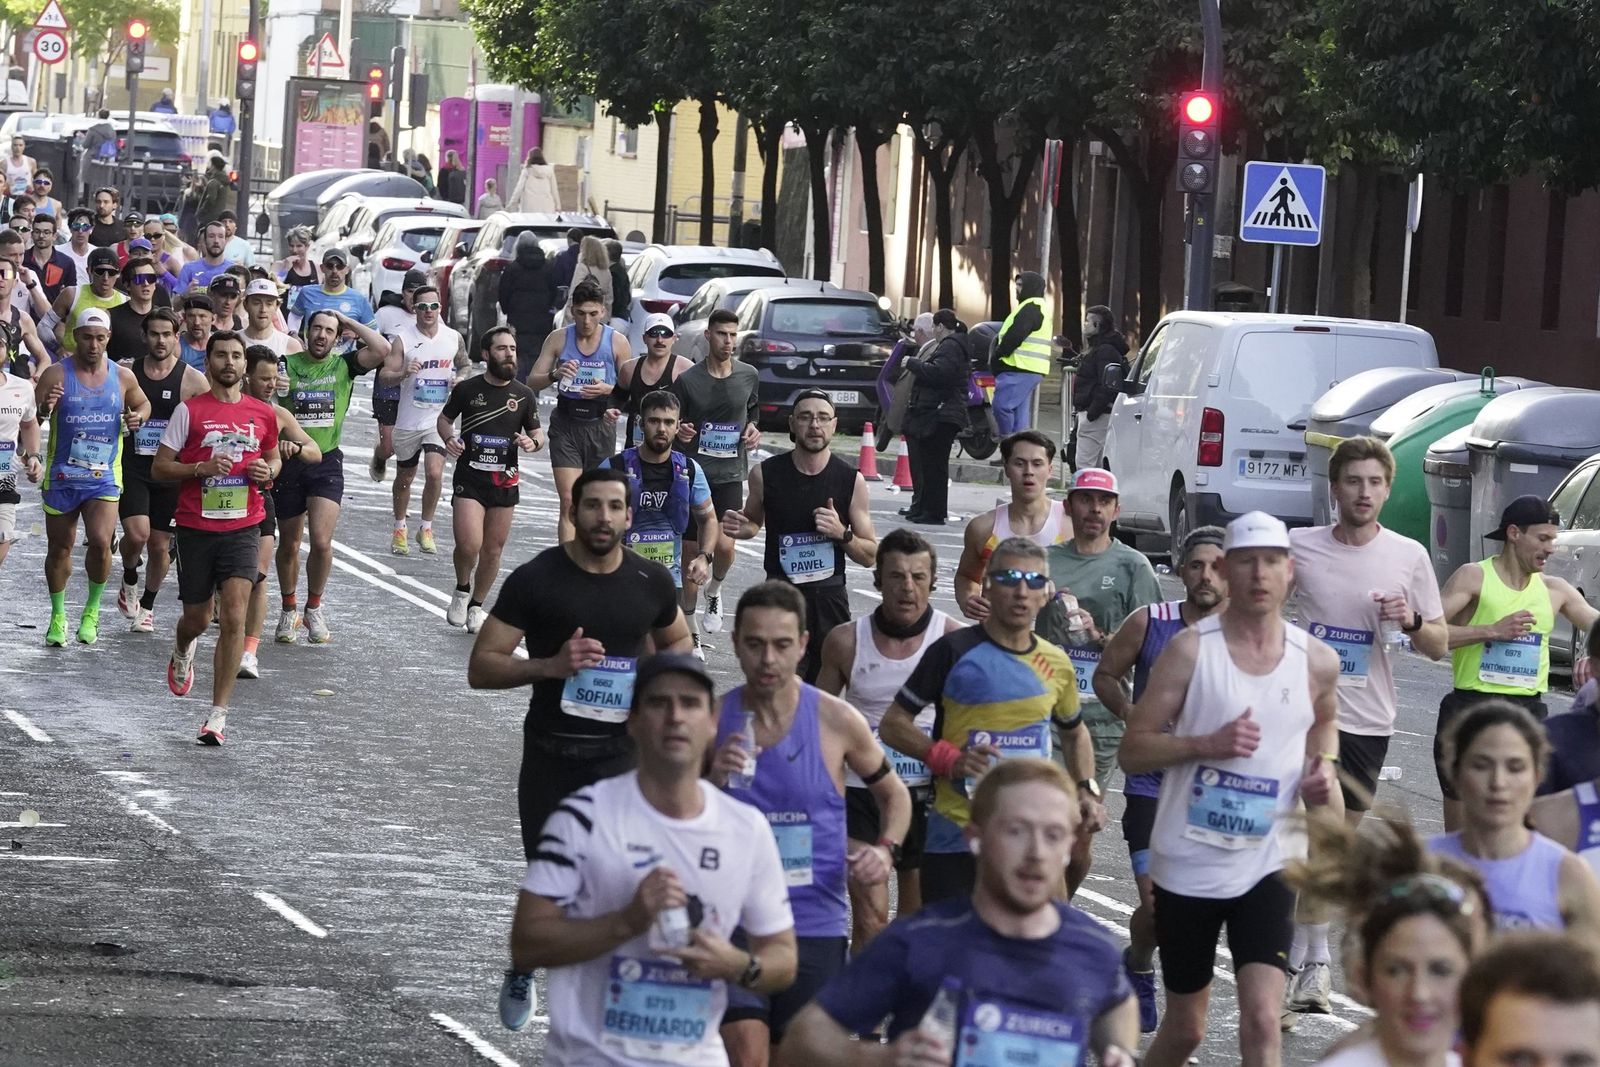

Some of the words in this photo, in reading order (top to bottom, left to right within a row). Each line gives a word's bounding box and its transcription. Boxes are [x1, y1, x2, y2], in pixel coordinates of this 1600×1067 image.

[41, 41, 61, 53] 30
[318, 411, 335, 419] PÉREZ
[699, 441, 738, 450] ALEJANDRO
[479, 454, 498, 464] SUSO
[1247, 462, 1279, 476] 9177
[1283, 464, 1308, 477] MFY
[218, 478, 244, 486] ZURICH
[218, 500, 234, 509] J.E.
[640, 491, 668, 508] CV
[796, 534, 828, 544] ZURICH
[790, 559, 825, 573] PAWEŁ
[1329, 629, 1367, 642] ZURICH
[1068, 648, 1102, 660] ZURICH
[597, 660, 631, 670] ZURICH
[576, 688, 623, 705] SOFIAN
[997, 736, 1037, 746] ZURICH
[1223, 775, 1271, 793] ZURICH
[1207, 811, 1255, 832] GAVIN
[604, 1009, 706, 1037] BERNARDO
